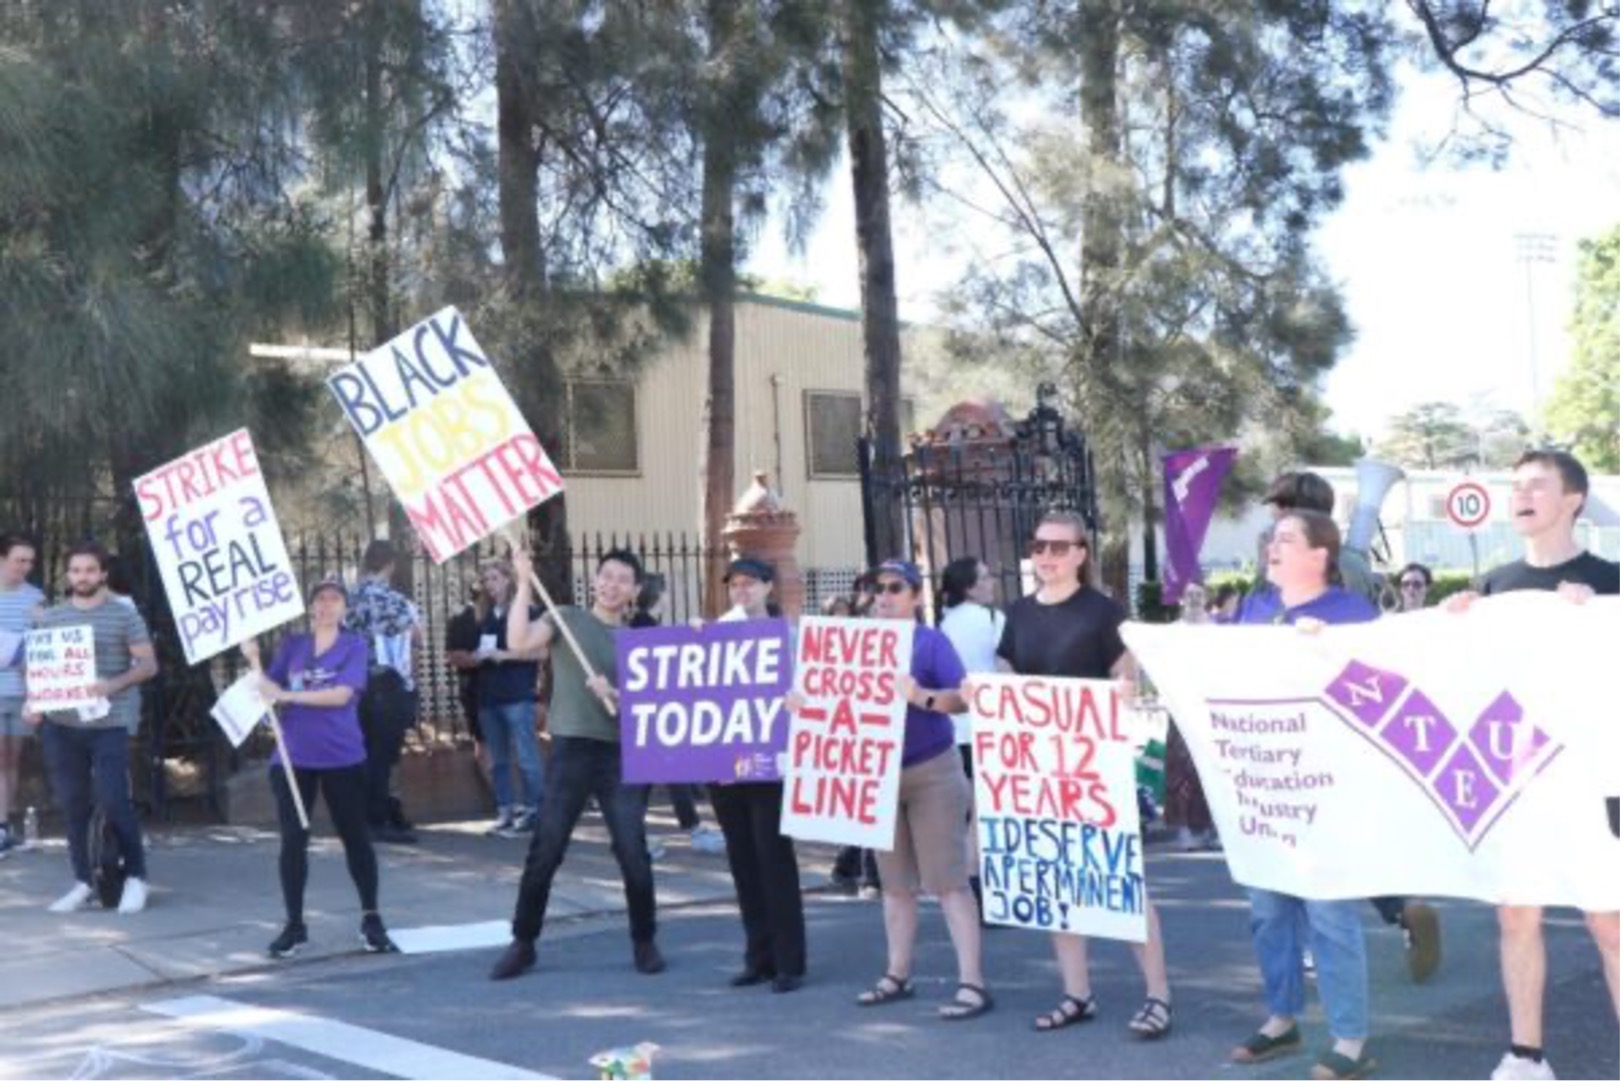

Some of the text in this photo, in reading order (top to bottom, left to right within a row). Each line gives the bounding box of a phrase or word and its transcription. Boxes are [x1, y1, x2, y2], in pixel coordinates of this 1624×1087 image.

[331, 314, 488, 436] BLACK
[376, 374, 512, 495] JOBS
[137, 431, 258, 521] STRIKE
[407, 432, 563, 564] MATTER
[164, 495, 267, 560] for a
[1457, 493, 1481, 517] 10
[177, 531, 278, 607] REAL
[64, 646, 91, 660] ALL
[625, 637, 782, 692] STRIKE
[801, 626, 899, 668] NEVER
[803, 667, 896, 705] CROSS
[631, 697, 785, 747] TODAY
[973, 680, 1128, 742] CASUAL
[1210, 712, 1307, 734] National
[793, 730, 896, 777] PICKET
[976, 731, 1100, 780] FOR 12
[1211, 738, 1302, 767] Tertiary
[791, 777, 880, 825] LINE
[981, 771, 1117, 828] YEARS
[1222, 768, 1335, 791] ducation
[991, 890, 1070, 931] JOB!
